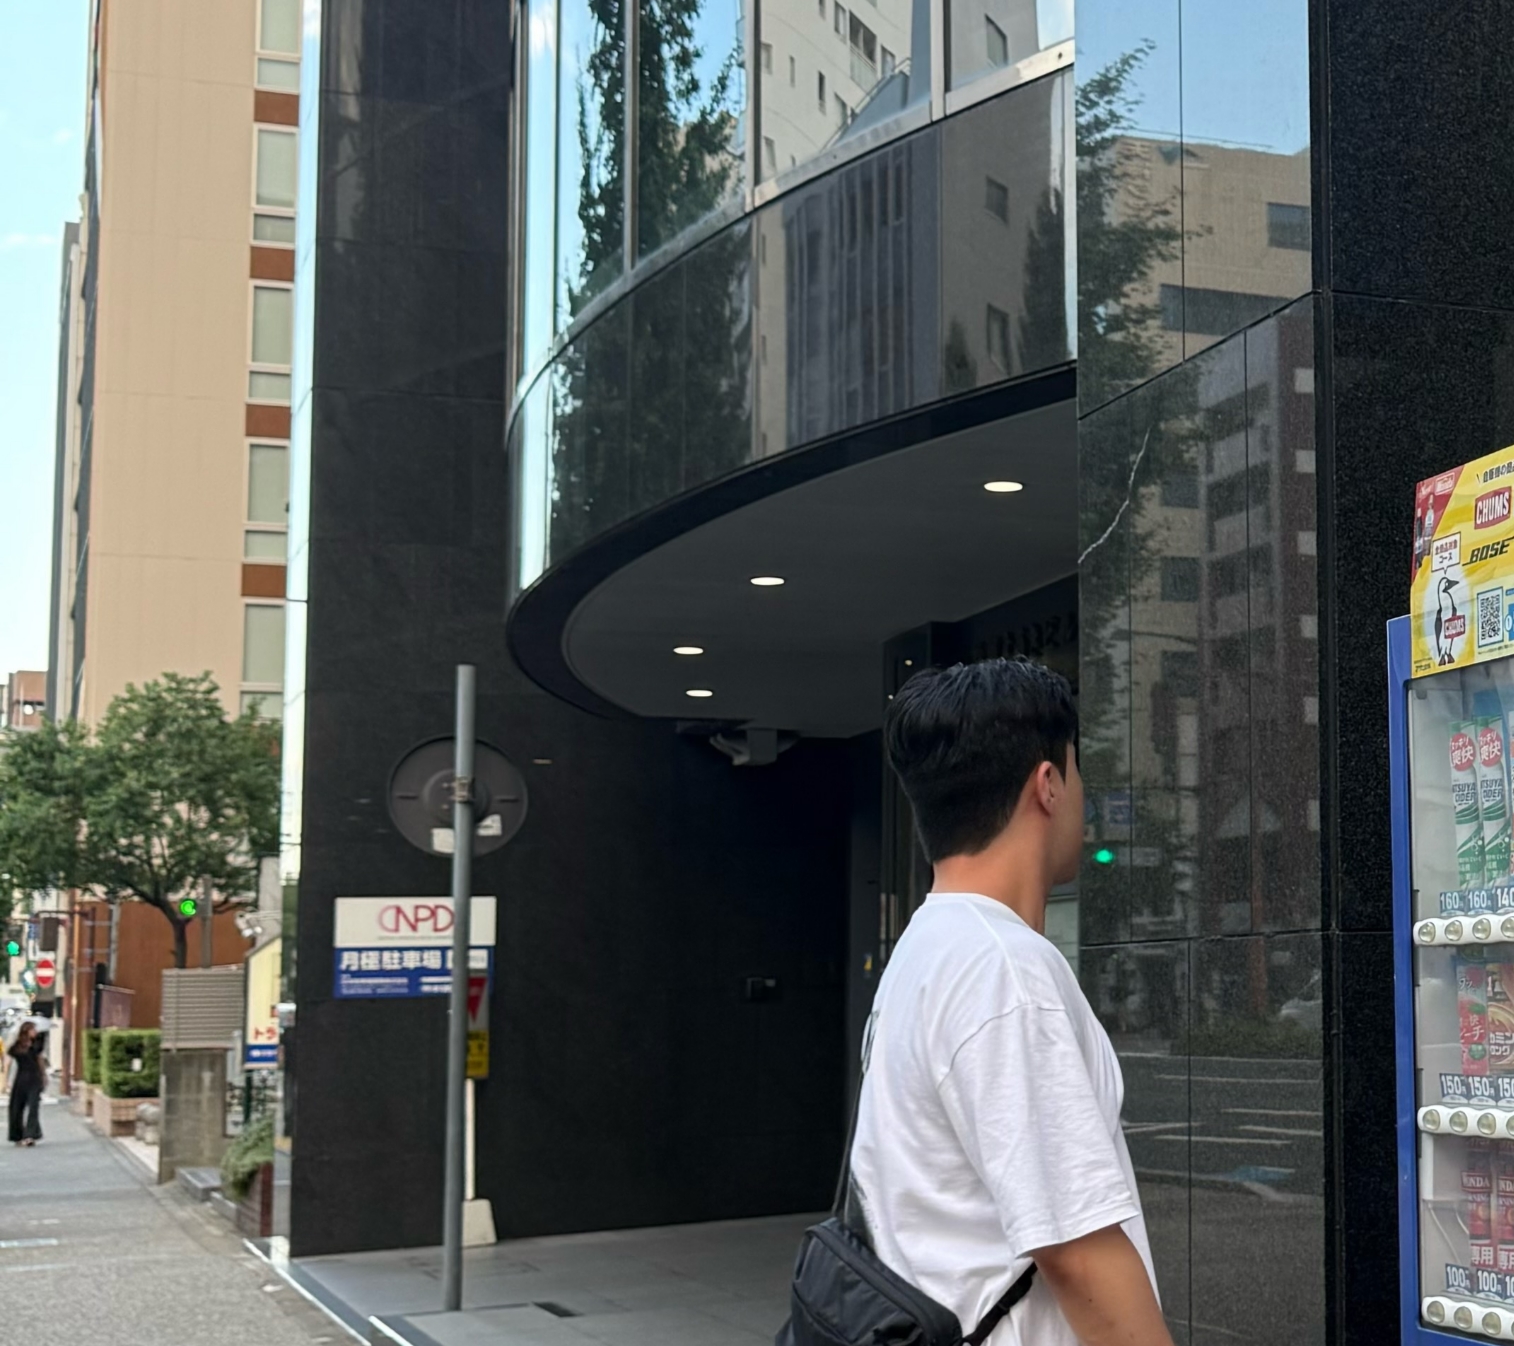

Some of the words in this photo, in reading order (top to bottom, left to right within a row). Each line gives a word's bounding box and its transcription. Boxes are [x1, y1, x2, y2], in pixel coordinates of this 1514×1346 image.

[1476, 492, 1509, 524] CHUMS
[1439, 553, 1453, 564] コース
[1462, 536, 1514, 566] BOSE
[1452, 747, 1473, 765] 爽快
[1481, 743, 1500, 761] 爽快
[1471, 1246, 1493, 1264] 専用
